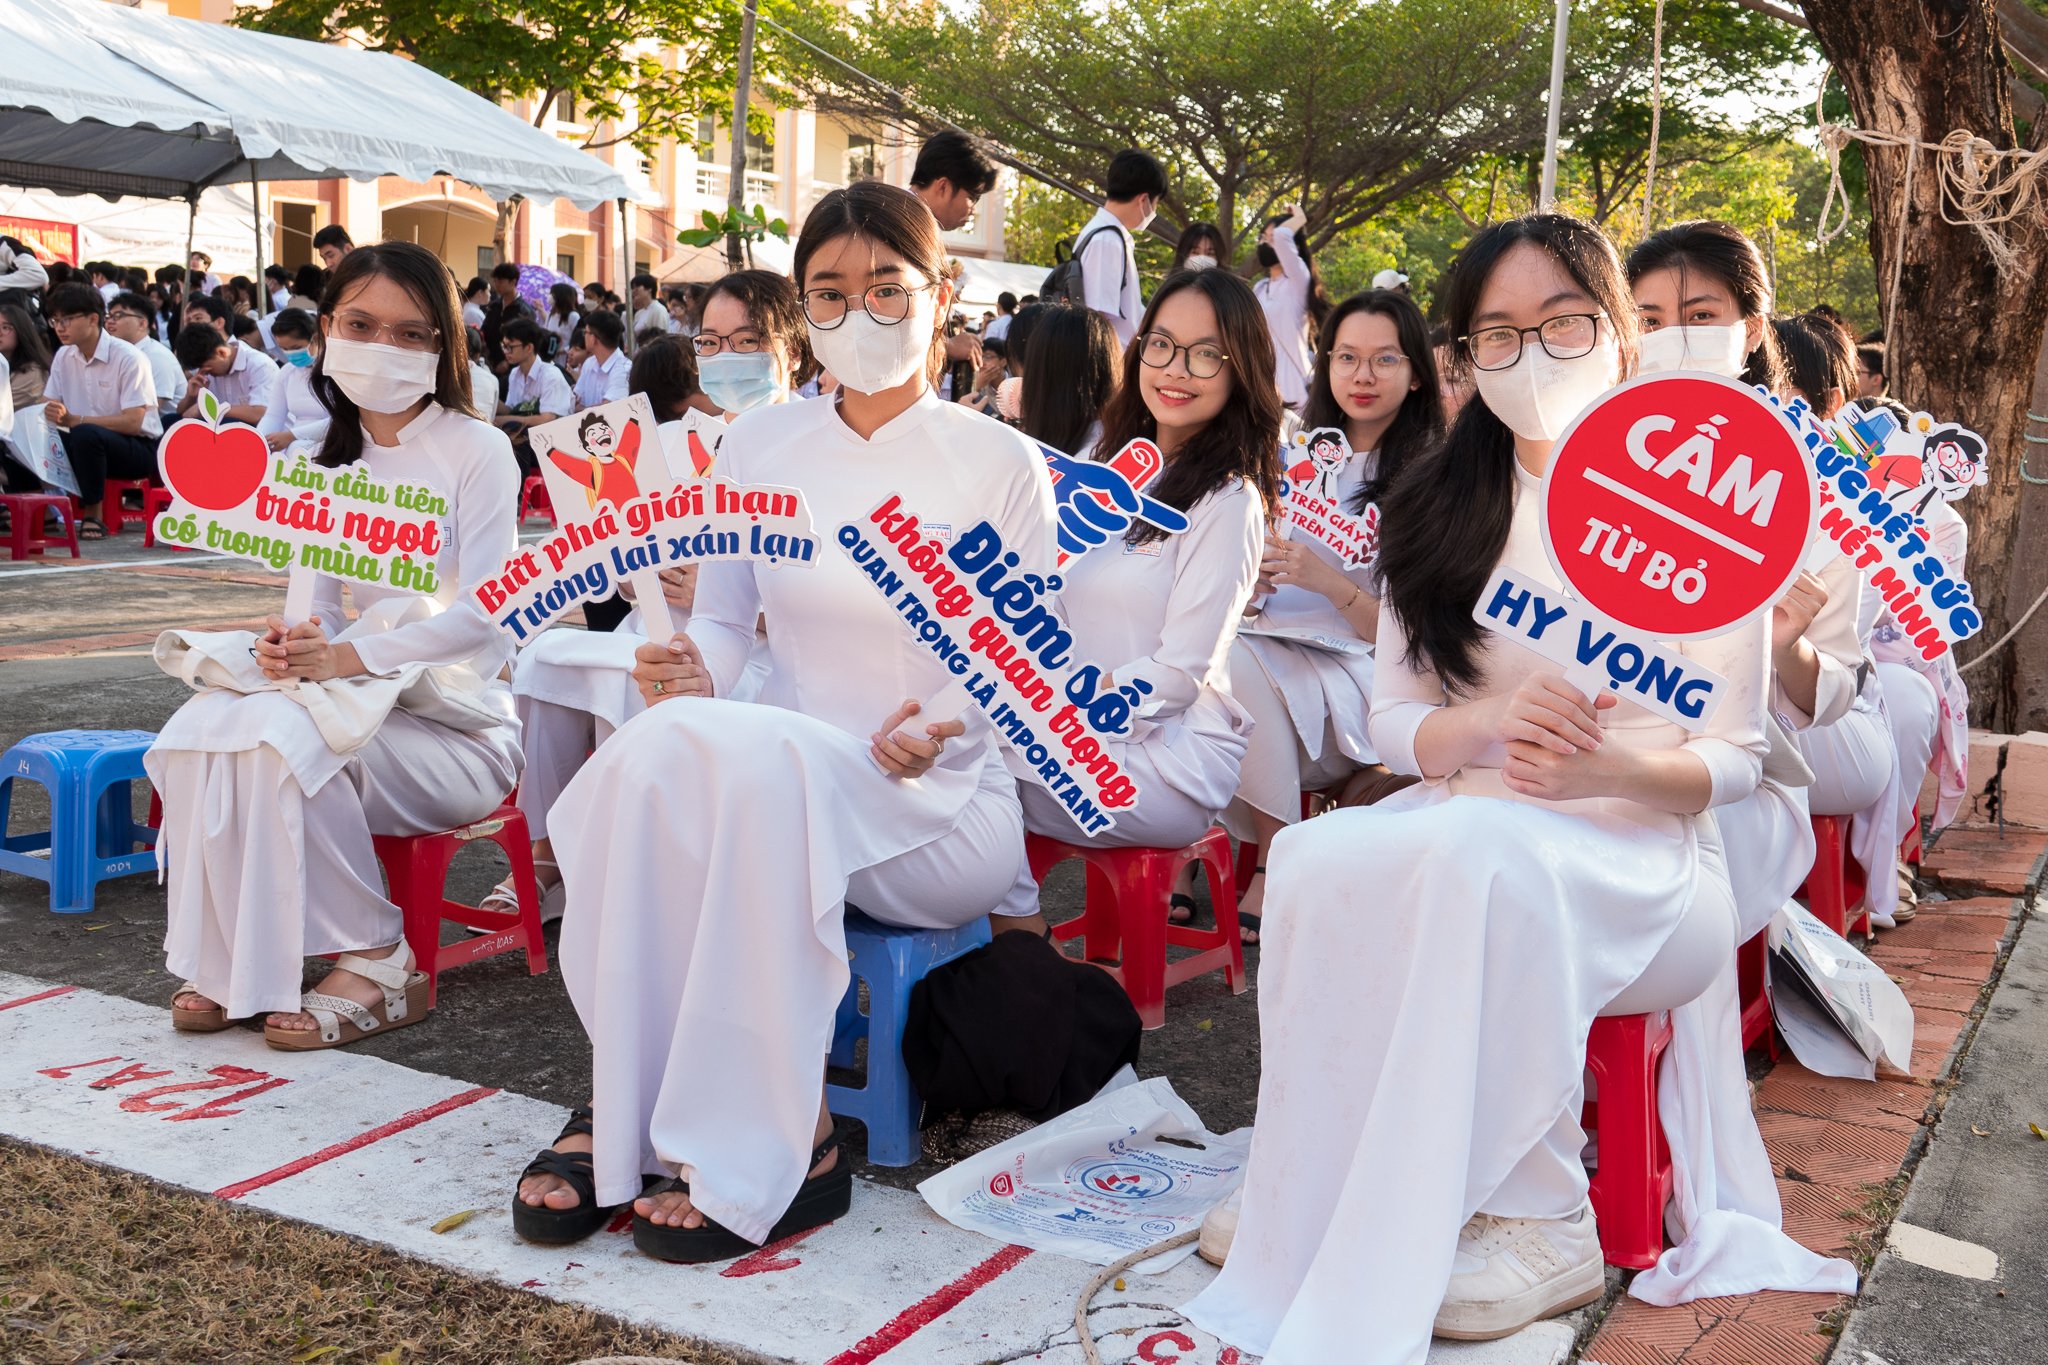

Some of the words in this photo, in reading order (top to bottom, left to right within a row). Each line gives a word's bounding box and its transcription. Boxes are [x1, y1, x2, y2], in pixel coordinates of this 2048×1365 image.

[256, 487, 334, 533] trái
[343, 511, 441, 561] ngọt
[275, 455, 327, 491] Lần
[334, 468, 385, 503] đầu
[395, 484, 448, 516] tiên
[1292, 492, 1327, 517] TRÊN
[1330, 515, 1365, 542] GIẤY
[1626, 415, 1782, 526] CẤM
[160, 514, 200, 543] có
[207, 520, 294, 569] trong
[300, 543, 382, 582] mùa
[390, 556, 439, 593] thi
[476, 552, 541, 614] Bứt
[543, 508, 619, 571] phá
[627, 485, 703, 536] giới
[715, 484, 798, 521] hạn
[502, 564, 607, 639] Tương
[611, 536, 659, 575] lai
[668, 526, 738, 559] xán
[750, 525, 814, 563] lạn
[1292, 512, 1325, 536] TRÊN
[1328, 533, 1354, 556] TAY
[1579, 518, 1646, 572] TỪ
[1640, 551, 1707, 603] BỎ
[1820, 508, 1882, 568] HẾT
[1871, 567, 1947, 660] MÌNH
[1859, 492, 1925, 558] HẾT
[1913, 557, 1978, 636] SỨC
[871, 496, 973, 618] không
[969, 617, 1053, 712] quan
[1049, 705, 1136, 808] trọng
[948, 522, 1072, 669] Điểm
[1487, 580, 1566, 639] HY
[1577, 621, 1712, 718] VỌNG
[839, 526, 903, 596] QUAN
[897, 593, 969, 674] TRỌNG
[965, 673, 997, 708] LÀ
[991, 703, 1109, 832] IMPORTANT
